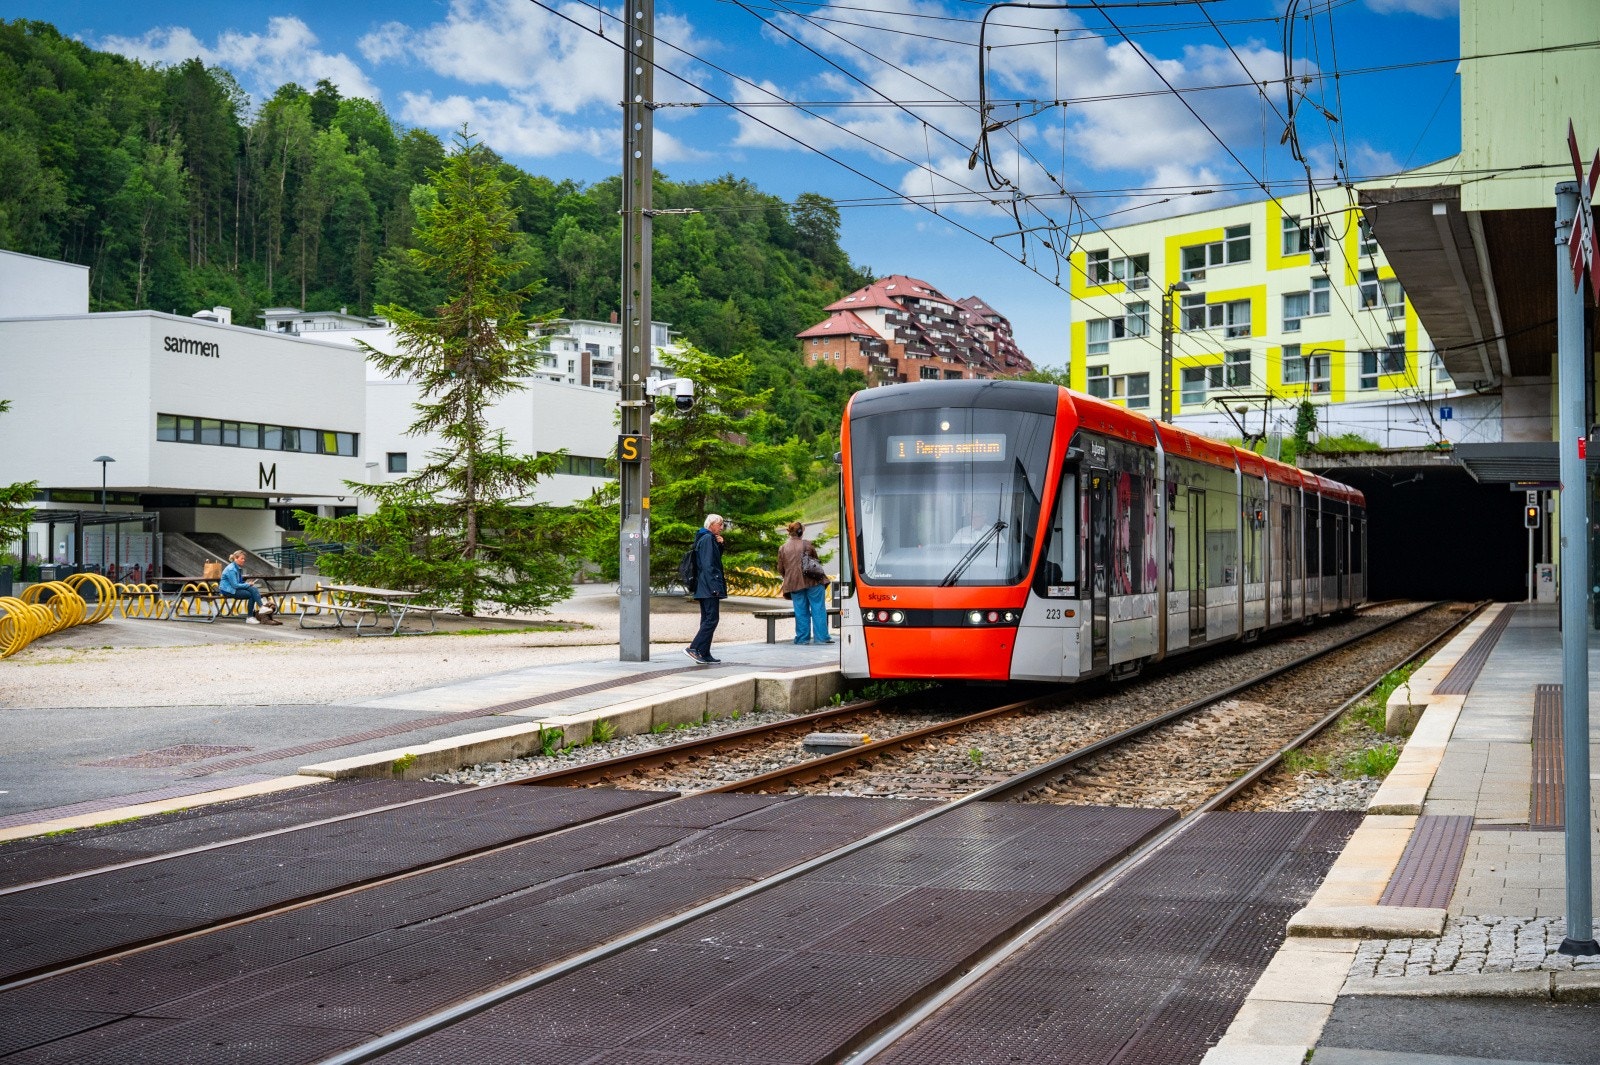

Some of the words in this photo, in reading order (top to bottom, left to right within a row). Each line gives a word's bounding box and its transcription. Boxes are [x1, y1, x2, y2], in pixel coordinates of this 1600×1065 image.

[164, 336, 220, 358] sammen
[622, 436, 638, 460] S
[898, 441, 906, 458] 1
[259, 461, 276, 490] M
[1528, 493, 1536, 504] E
[868, 592, 891, 602] skyss
[1046, 608, 1061, 620] 223
